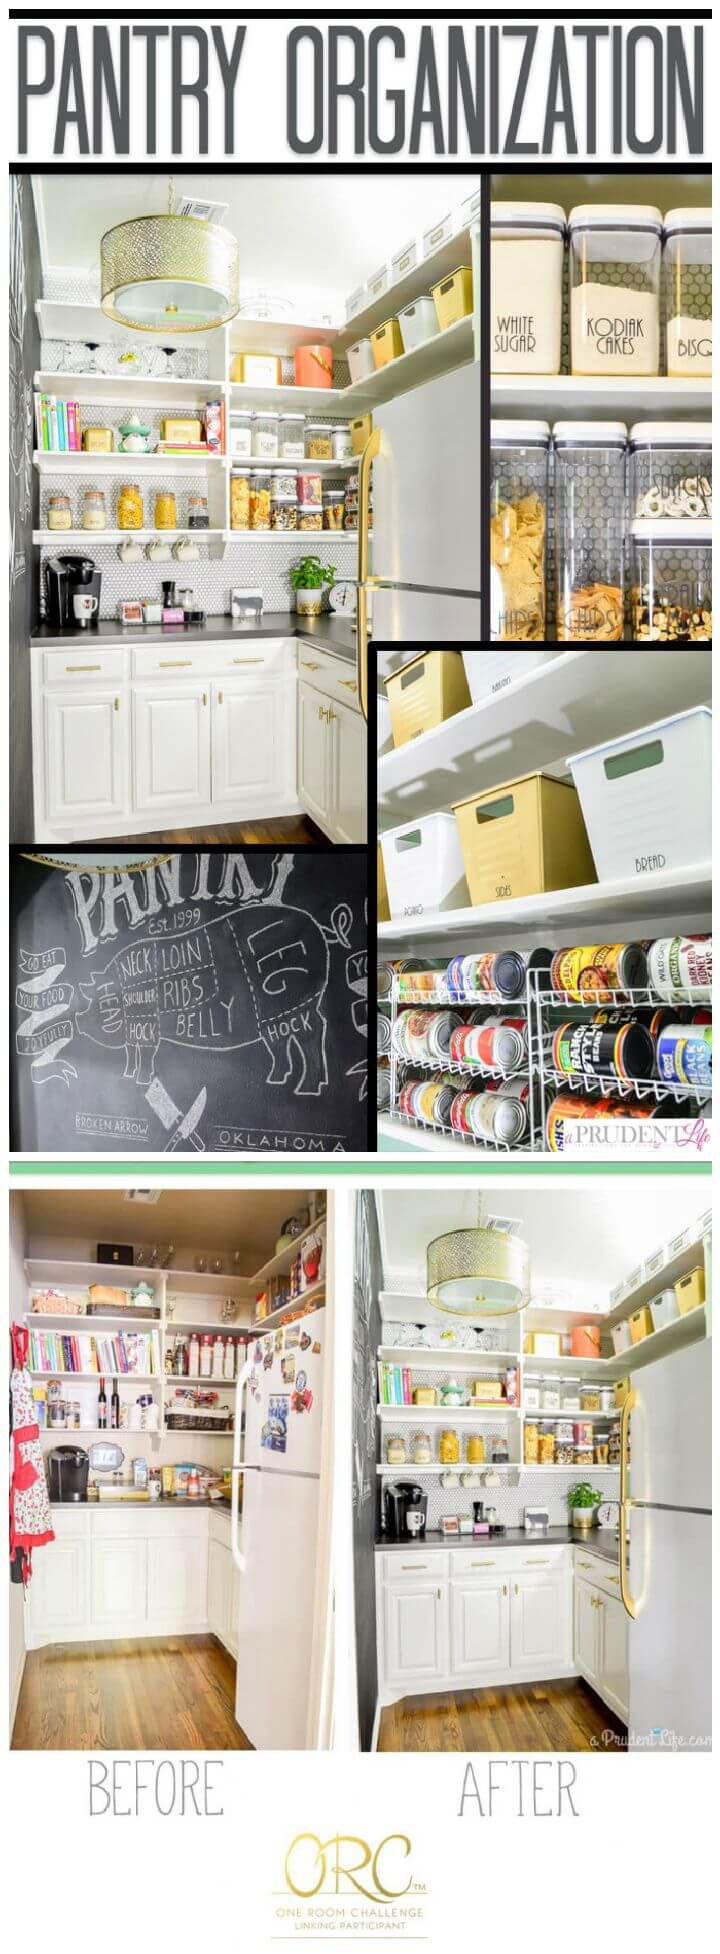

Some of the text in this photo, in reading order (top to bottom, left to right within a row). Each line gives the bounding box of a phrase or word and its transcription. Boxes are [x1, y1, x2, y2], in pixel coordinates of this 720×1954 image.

[497, 316, 534, 335] WHITE
[587, 317, 644, 337] KODIAK
[494, 335, 537, 353] SUGAR
[596, 336, 635, 355] CAKES
[635, 854, 666, 874] BREAD
[148, 908, 201, 935] Est. 1999
[28, 951, 57, 971] GO EAT
[120, 947, 152, 981] NECK
[162, 937, 201, 971] LOIN
[247, 920, 308, 996] LEG
[19, 988, 65, 1009] YOUR FOOD
[163, 975, 204, 1009] RIBS
[97, 982, 123, 1033] HEAD
[176, 996, 235, 1037] BELLY
[23, 1024, 68, 1052] JOYFULLY
[130, 1022, 156, 1041] HOCK
[268, 1010, 313, 1044] HOCK
[570, 1024, 588, 1070] RANCH
[75, 1114, 149, 1135] BROKEN ARROW
